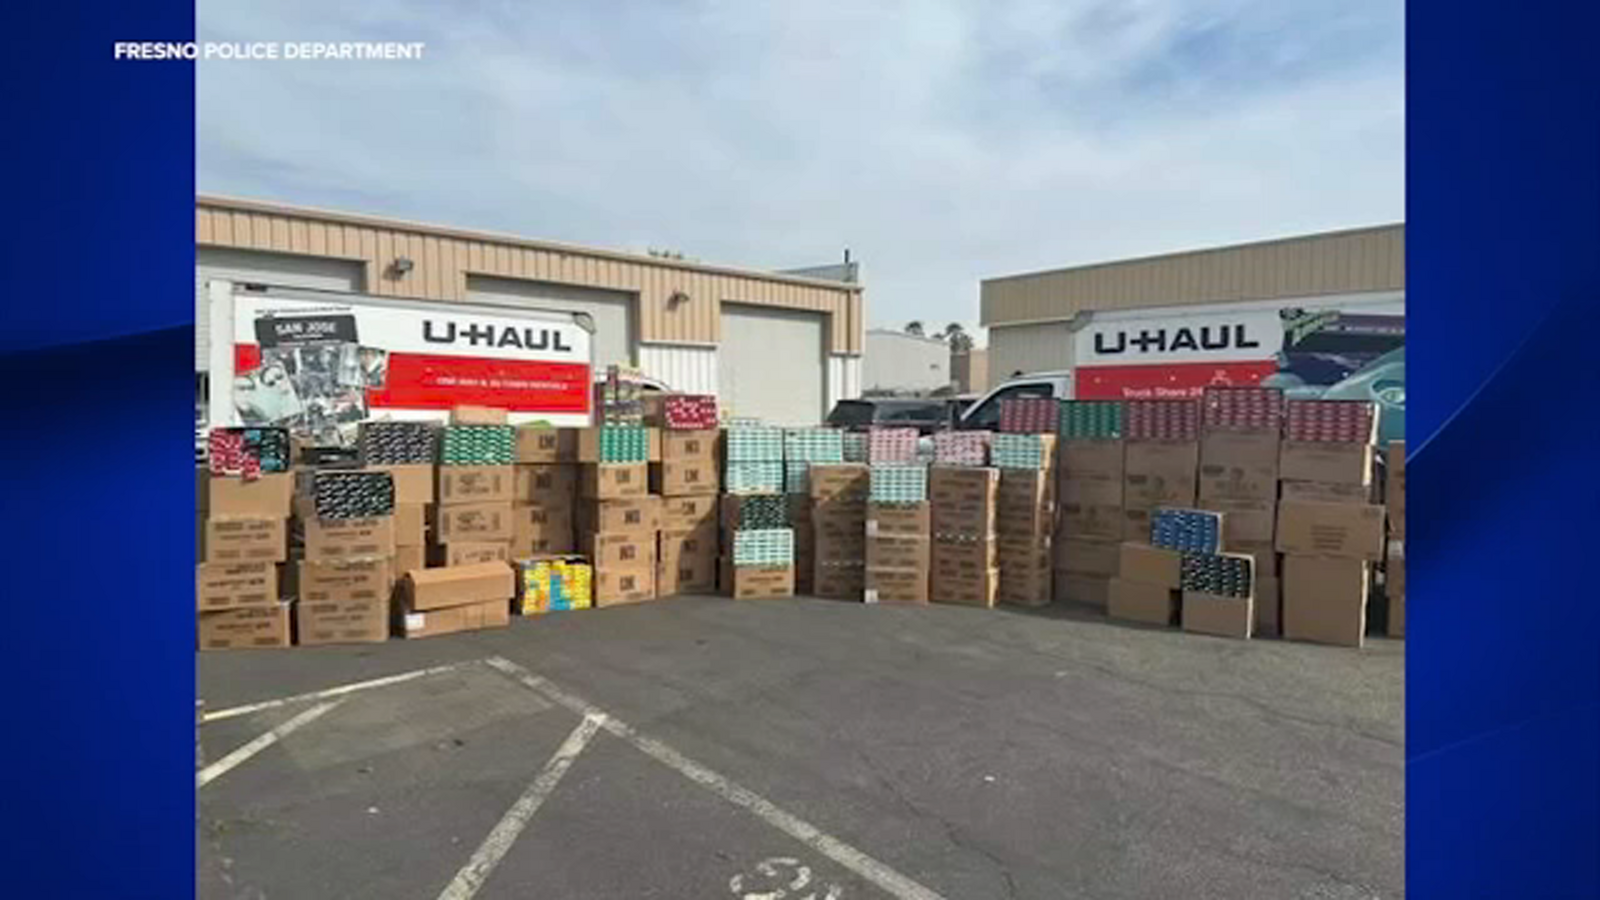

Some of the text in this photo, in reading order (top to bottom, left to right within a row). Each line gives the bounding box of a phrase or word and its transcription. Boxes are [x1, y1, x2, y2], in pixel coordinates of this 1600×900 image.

[275, 320, 337, 335] SAN JOSE
[423, 320, 571, 352] U-HAUL
[1094, 325, 1260, 354] U-HAUL
[1122, 386, 1151, 397] Truck
[1155, 386, 1186, 397] Share
